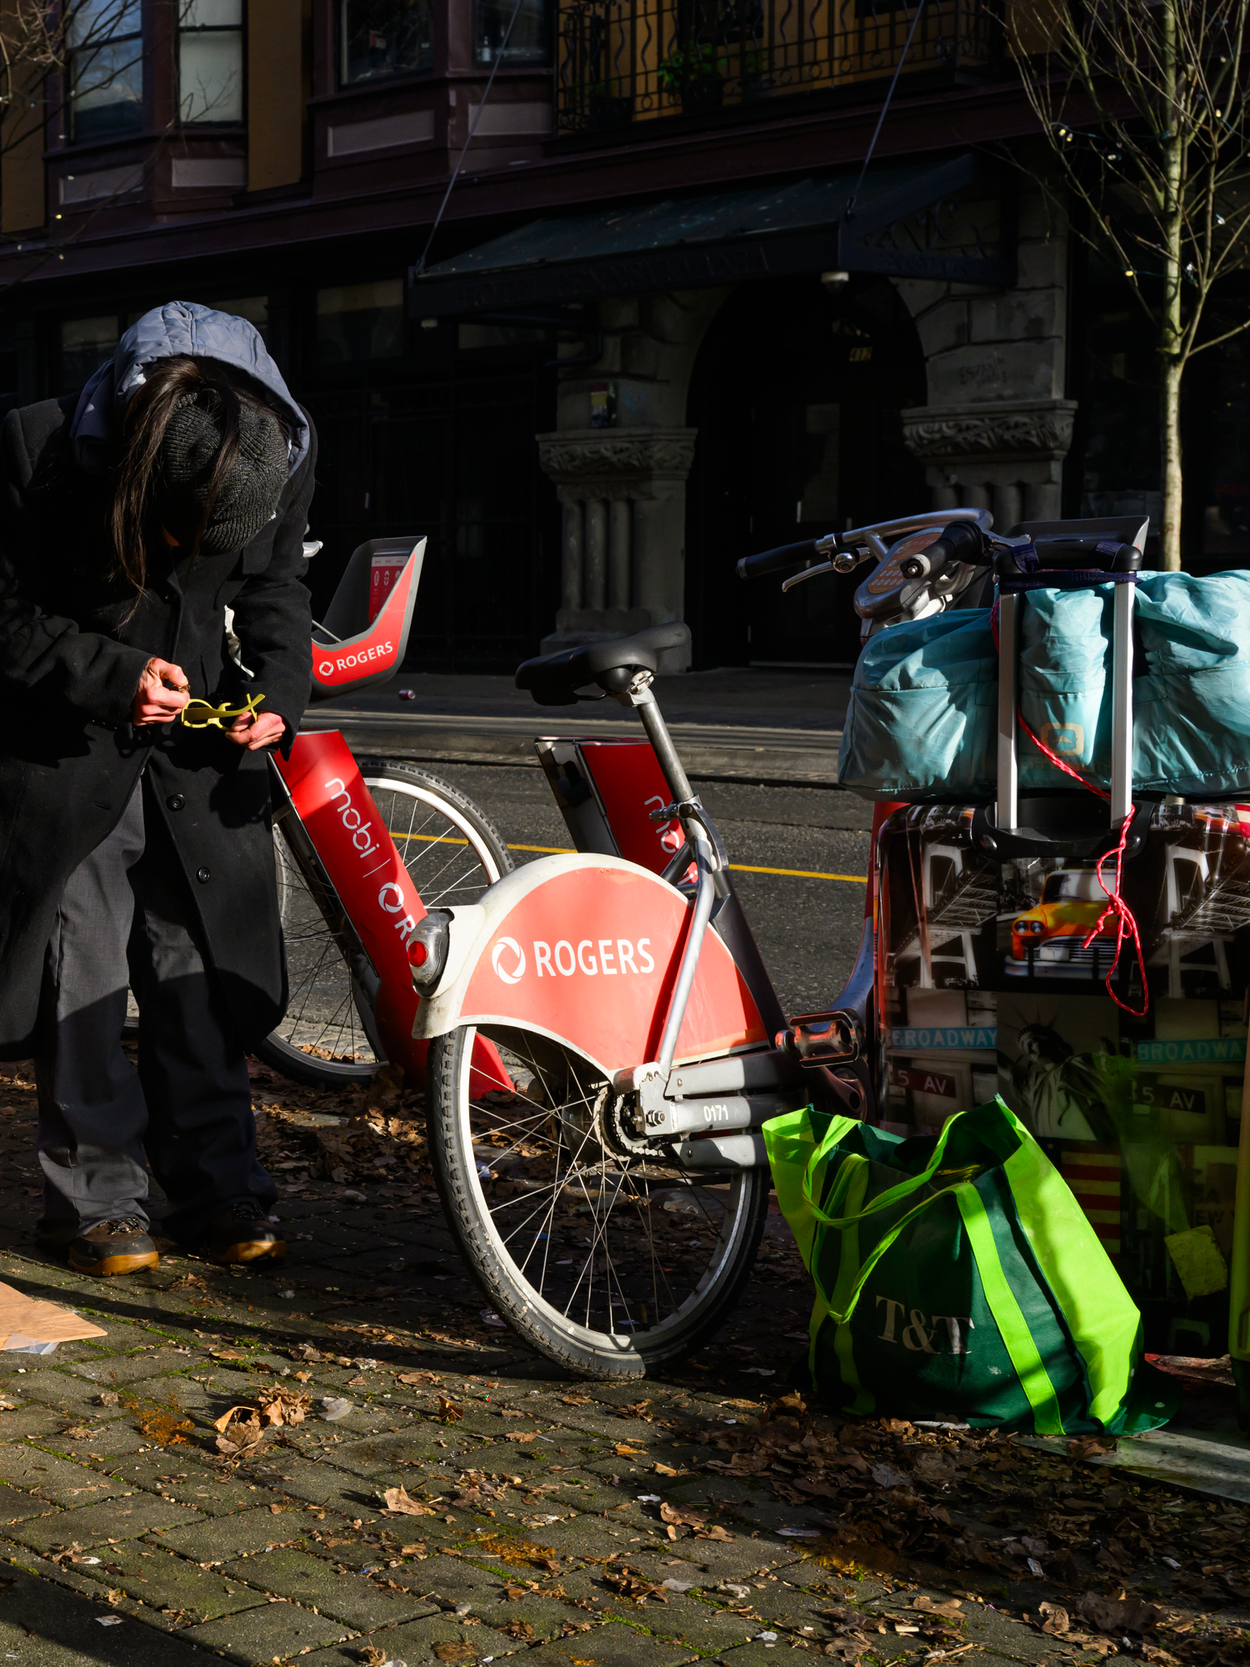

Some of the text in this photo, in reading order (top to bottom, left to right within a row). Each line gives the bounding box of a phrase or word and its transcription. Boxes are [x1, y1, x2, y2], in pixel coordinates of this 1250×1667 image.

[336, 641, 394, 671] ROGERS
[324, 777, 380, 858] mobi
[644, 795, 699, 886] moi
[534, 937, 655, 977] ROGERS
[892, 1029, 997, 1047] BROADWAY
[1137, 1040, 1246, 1061] BROADWA
[897, 1069, 947, 1095] 5 AV
[1142, 1086, 1196, 1111] 5 AV
[703, 1104, 729, 1122] 0171
[875, 1294, 975, 1356] T&T
